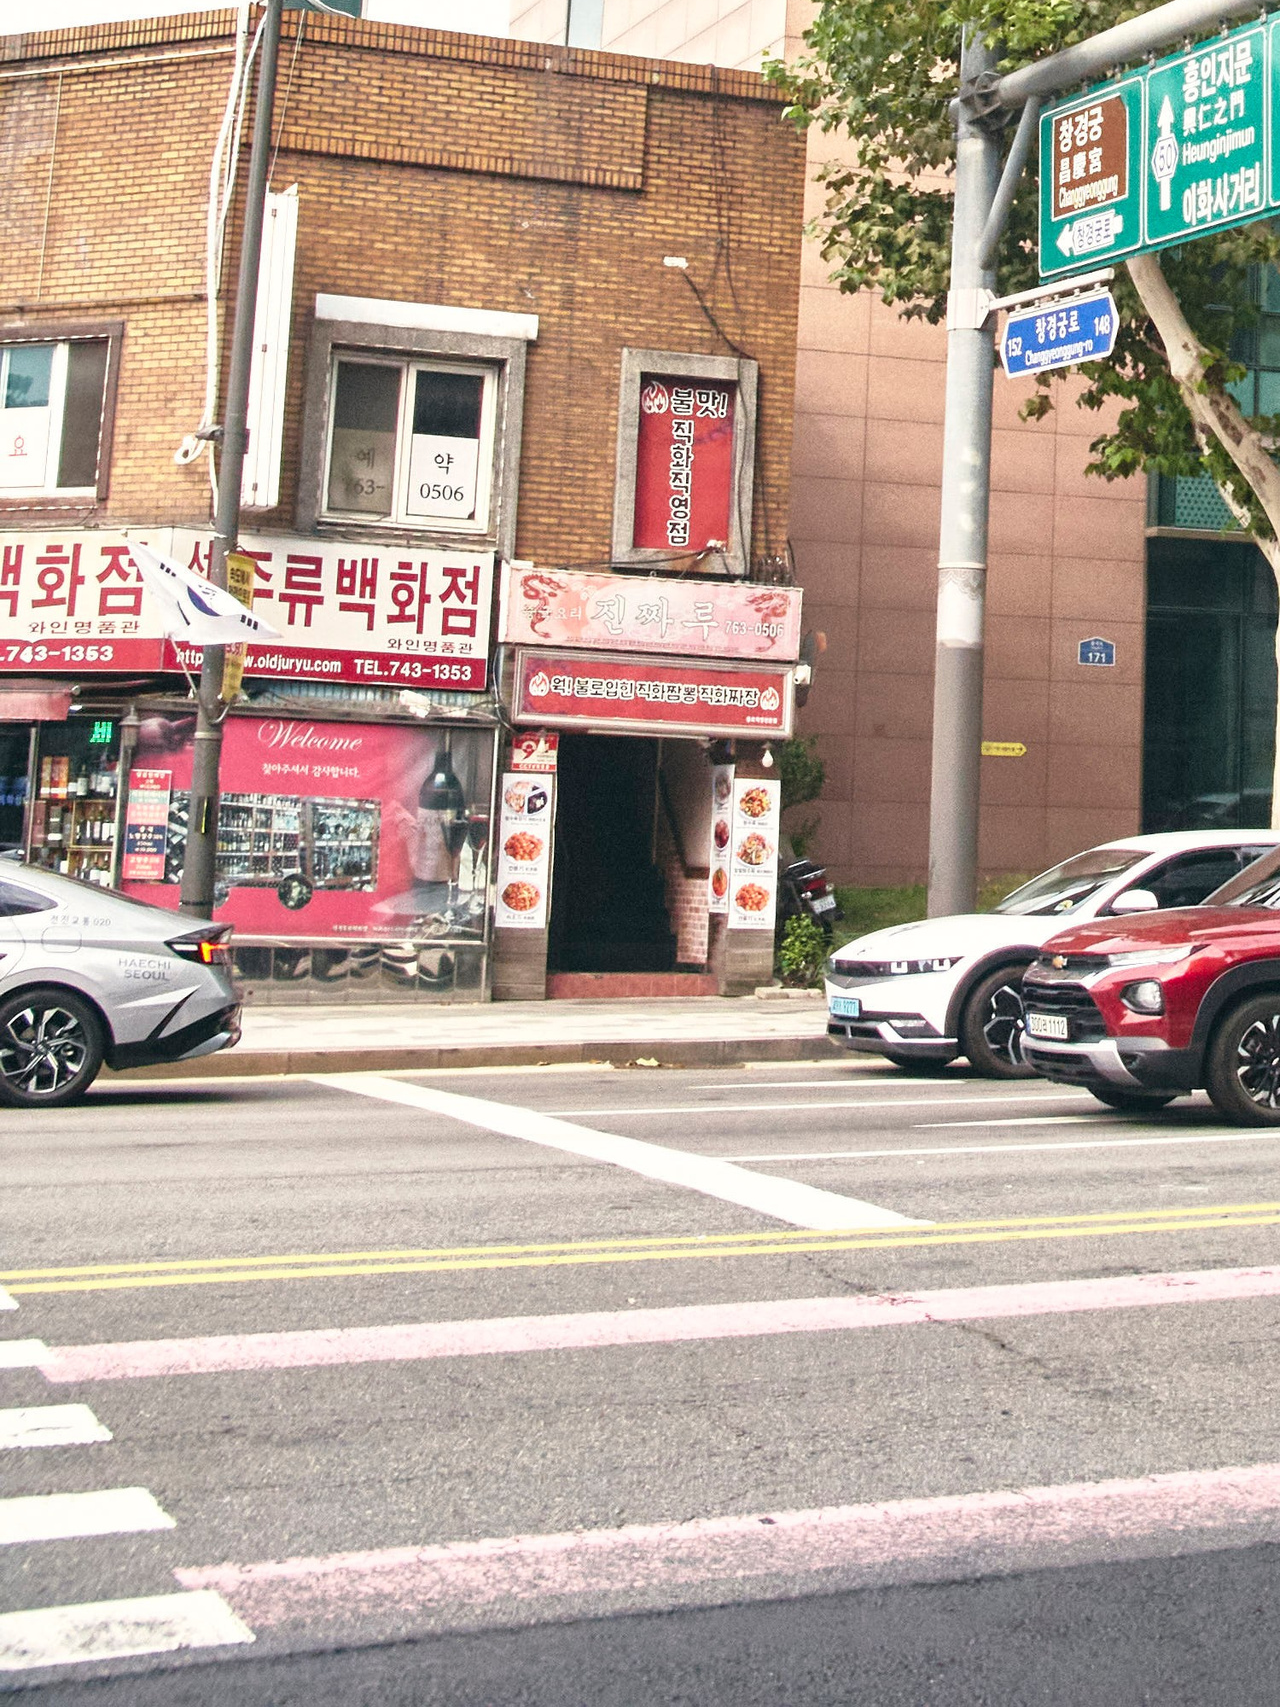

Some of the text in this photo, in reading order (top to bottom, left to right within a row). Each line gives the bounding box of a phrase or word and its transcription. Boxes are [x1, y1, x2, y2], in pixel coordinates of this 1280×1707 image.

[1182, 39, 1253, 103] 흥인지문
[1058, 105, 1104, 153] 창경궁
[1157, 143, 1174, 172] 50
[1182, 125, 1255, 166] Heunginjimun
[1058, 174, 1119, 209] Changgyeonggung
[1182, 161, 1260, 226] 이화사거리
[1076, 217, 1112, 249] 창경궁로
[1035, 310, 1081, 344] 창경궁로
[1093, 314, 1111, 336] 148
[1007, 337, 1023, 357] 152
[1025, 339, 1093, 366] Changgyeonggung-ro
[8, 434, 28, 457] 요
[434, 452, 455, 475] 약
[420, 483, 464, 502] 0506
[668, 419, 694, 547] 직화직영점
[28, 620, 140, 635] 와인명품관
[725, 620, 784, 637] 763-0506
[387, 638, 473, 655] 와인명품관
[1087, 652, 1106, 664] 171
[354, 658, 472, 681] TEL.743-1353
[574, 677, 634, 699] 불로입힌
[636, 681, 698, 704] 직화짬뽕
[699, 685, 760, 707] 직화짜장
[257, 719, 364, 751] Welcome
[118, 958, 171, 969] HAECHI
[123, 969, 169, 981] SEOUL
